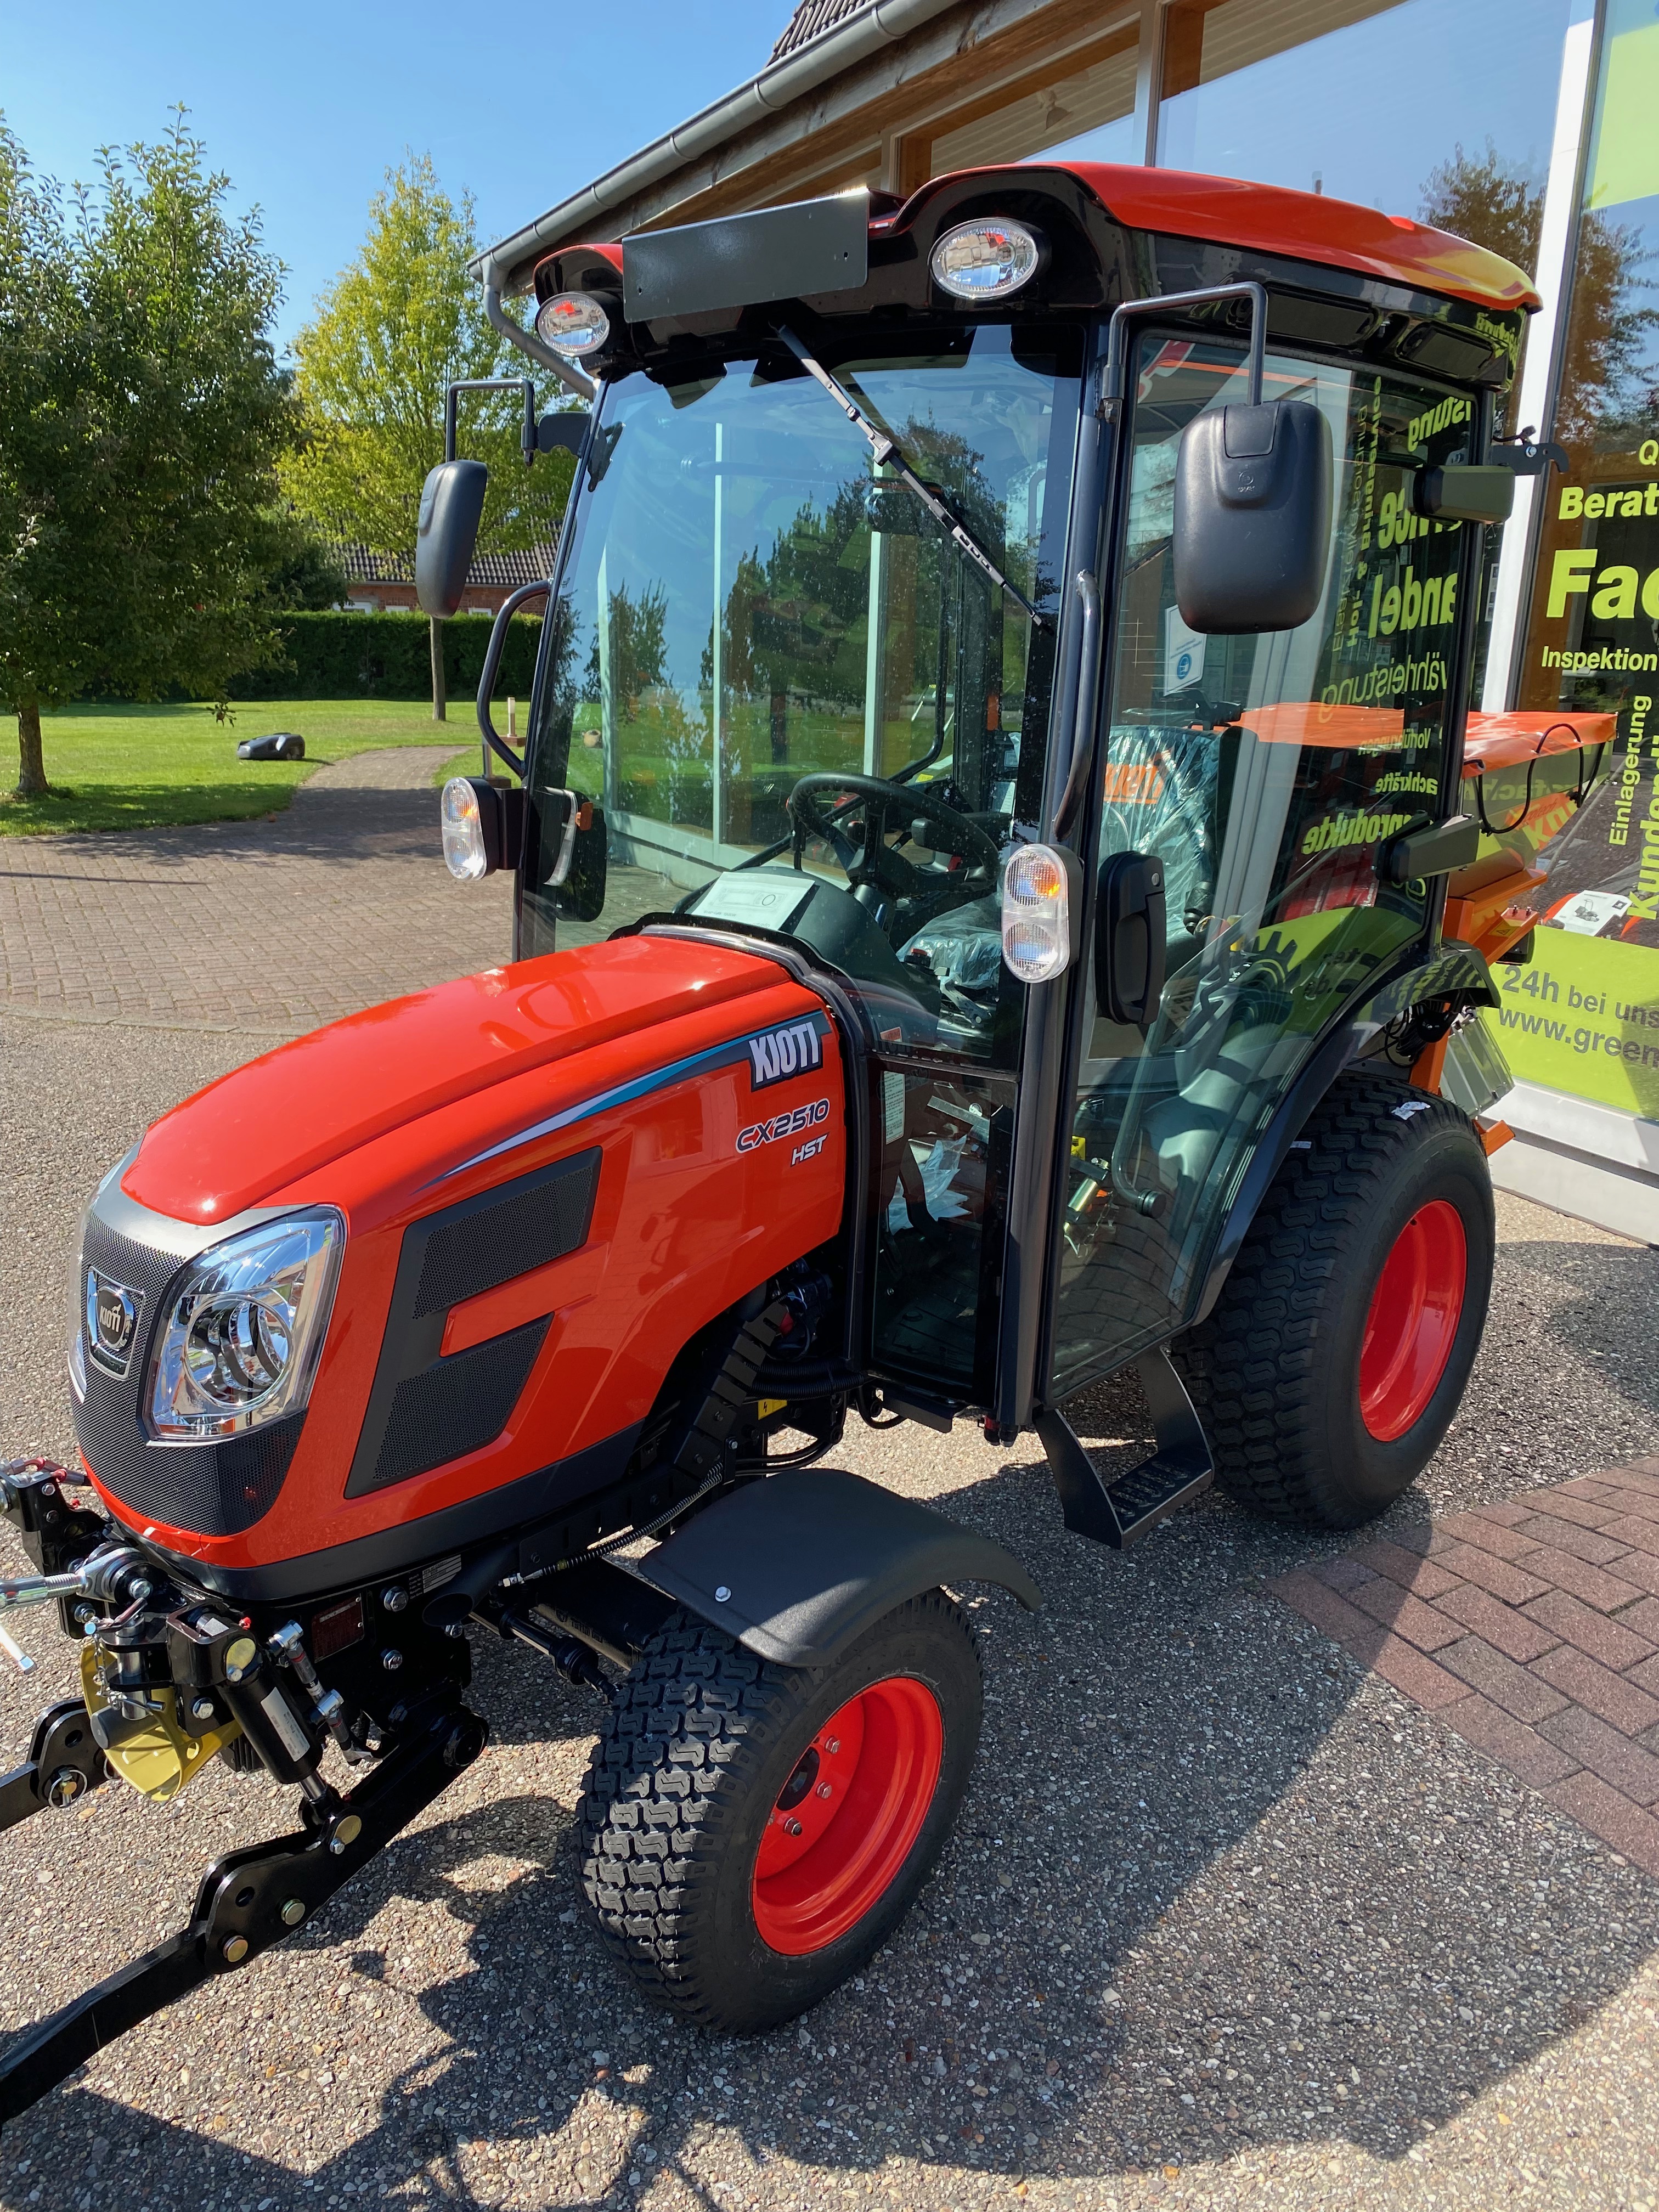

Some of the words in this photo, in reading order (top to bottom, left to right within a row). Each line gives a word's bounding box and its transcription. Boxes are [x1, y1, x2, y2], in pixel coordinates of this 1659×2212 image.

[1542, 646, 1658, 674] Inspektion
[1609, 695, 1652, 845] Einlagerung
[1502, 965, 1559, 1003] 24h
[1568, 985, 1606, 1014] bei
[749, 1022, 819, 1084] KIOTI
[736, 1098, 830, 1154] CX2510
[791, 1133, 828, 1165] HST
[99, 1304, 121, 1333] KIOTI
